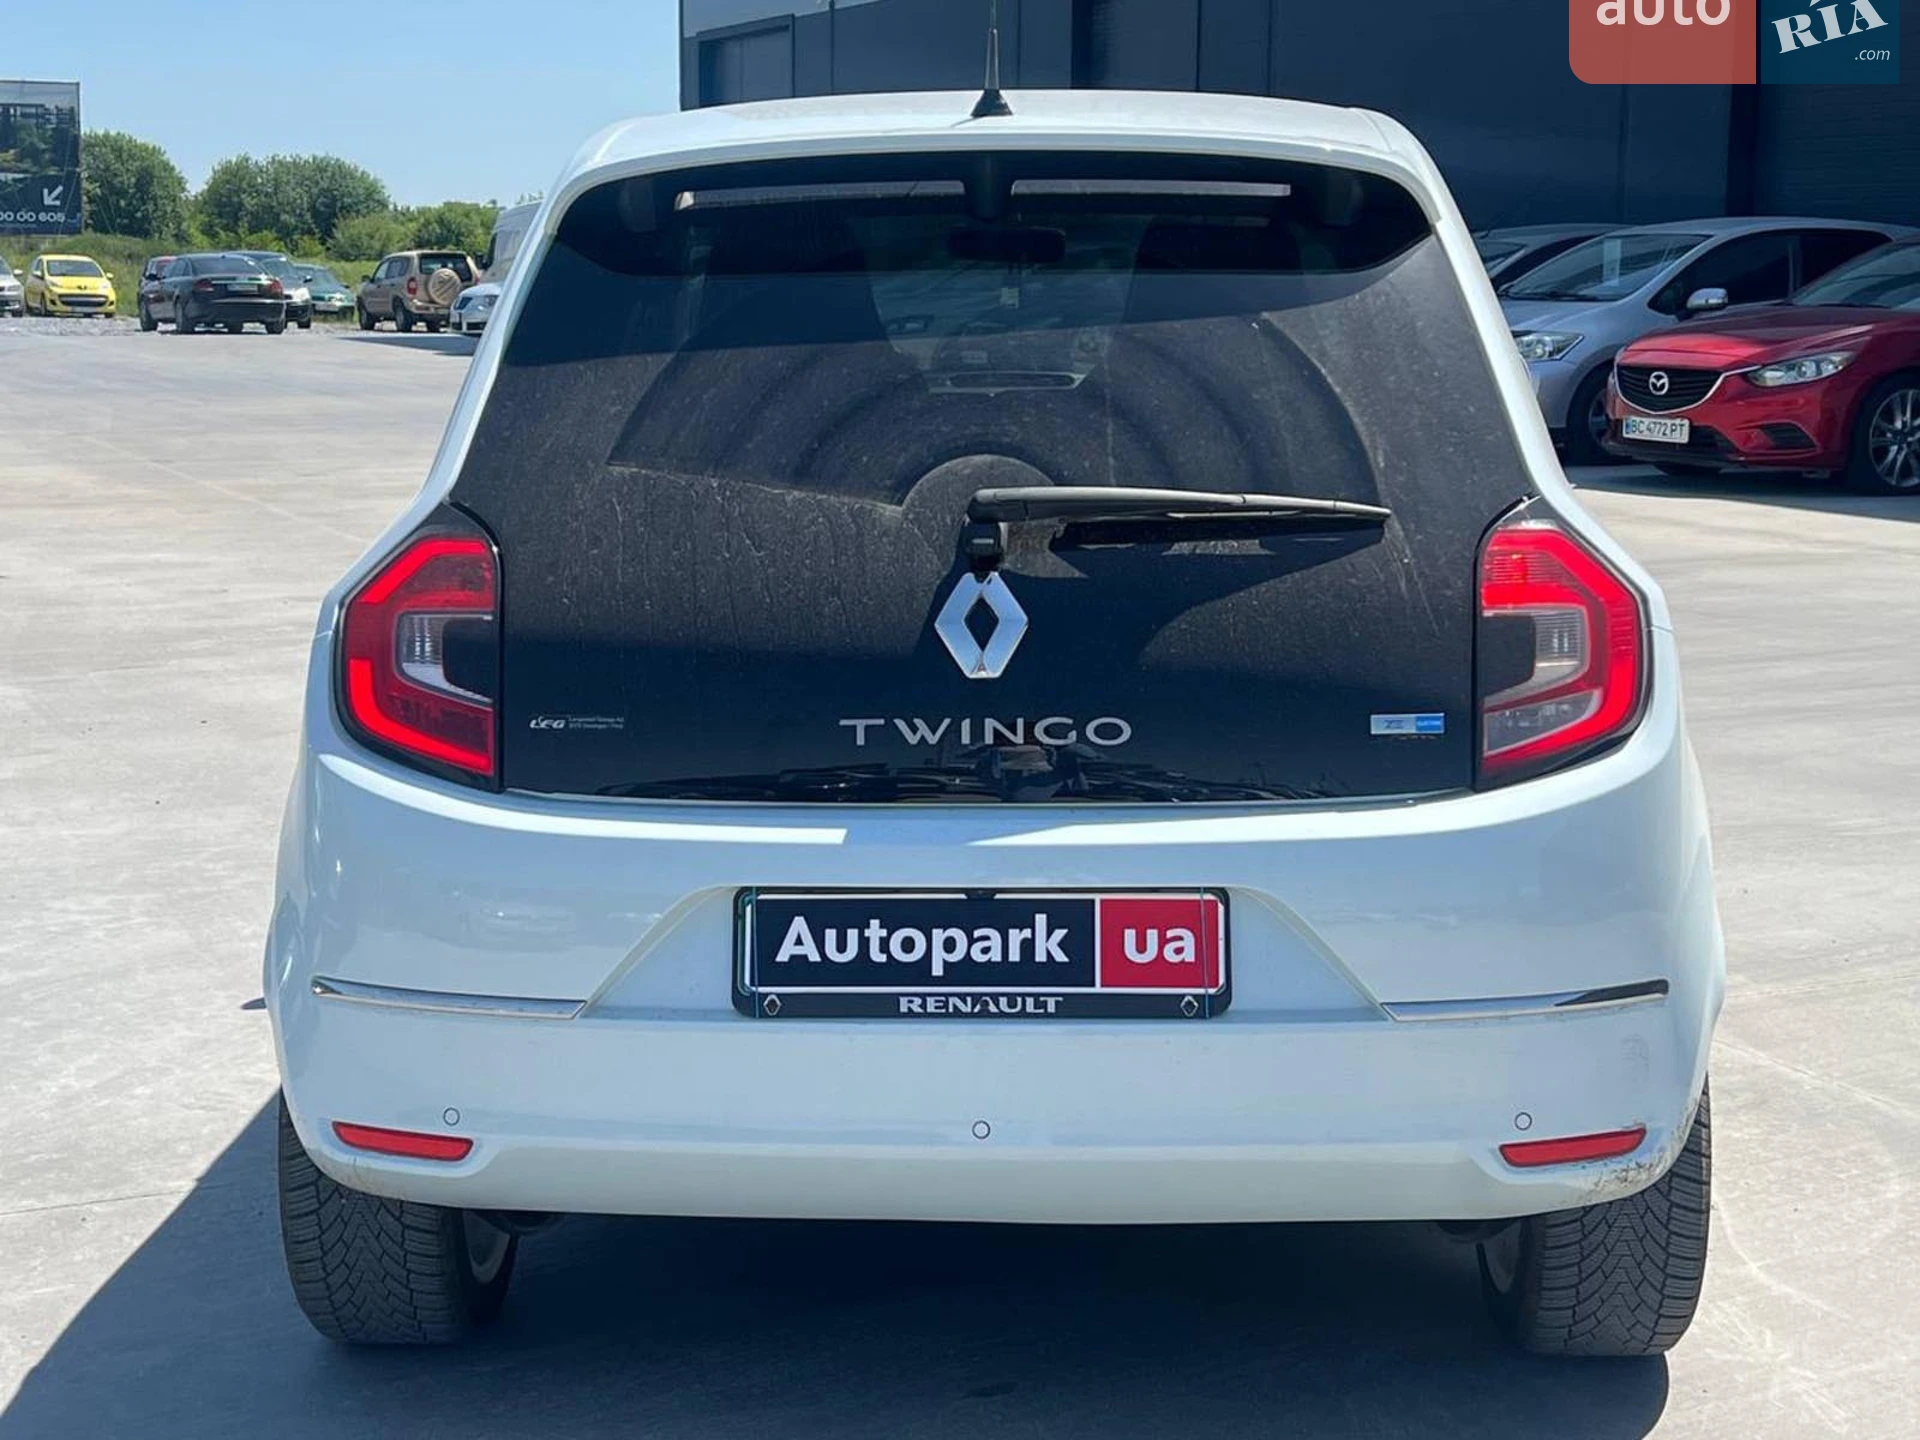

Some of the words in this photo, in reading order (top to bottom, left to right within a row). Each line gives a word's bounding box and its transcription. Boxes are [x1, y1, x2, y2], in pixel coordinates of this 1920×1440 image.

[1632, 420, 1645, 434] BC
[1646, 421, 1668, 437] 4772
[1670, 422, 1686, 437] PT
[839, 716, 1132, 746] TWINGO
[775, 913, 1069, 977] Autopark
[1123, 928, 1196, 963] ua
[898, 995, 1064, 1014] RENAULT
